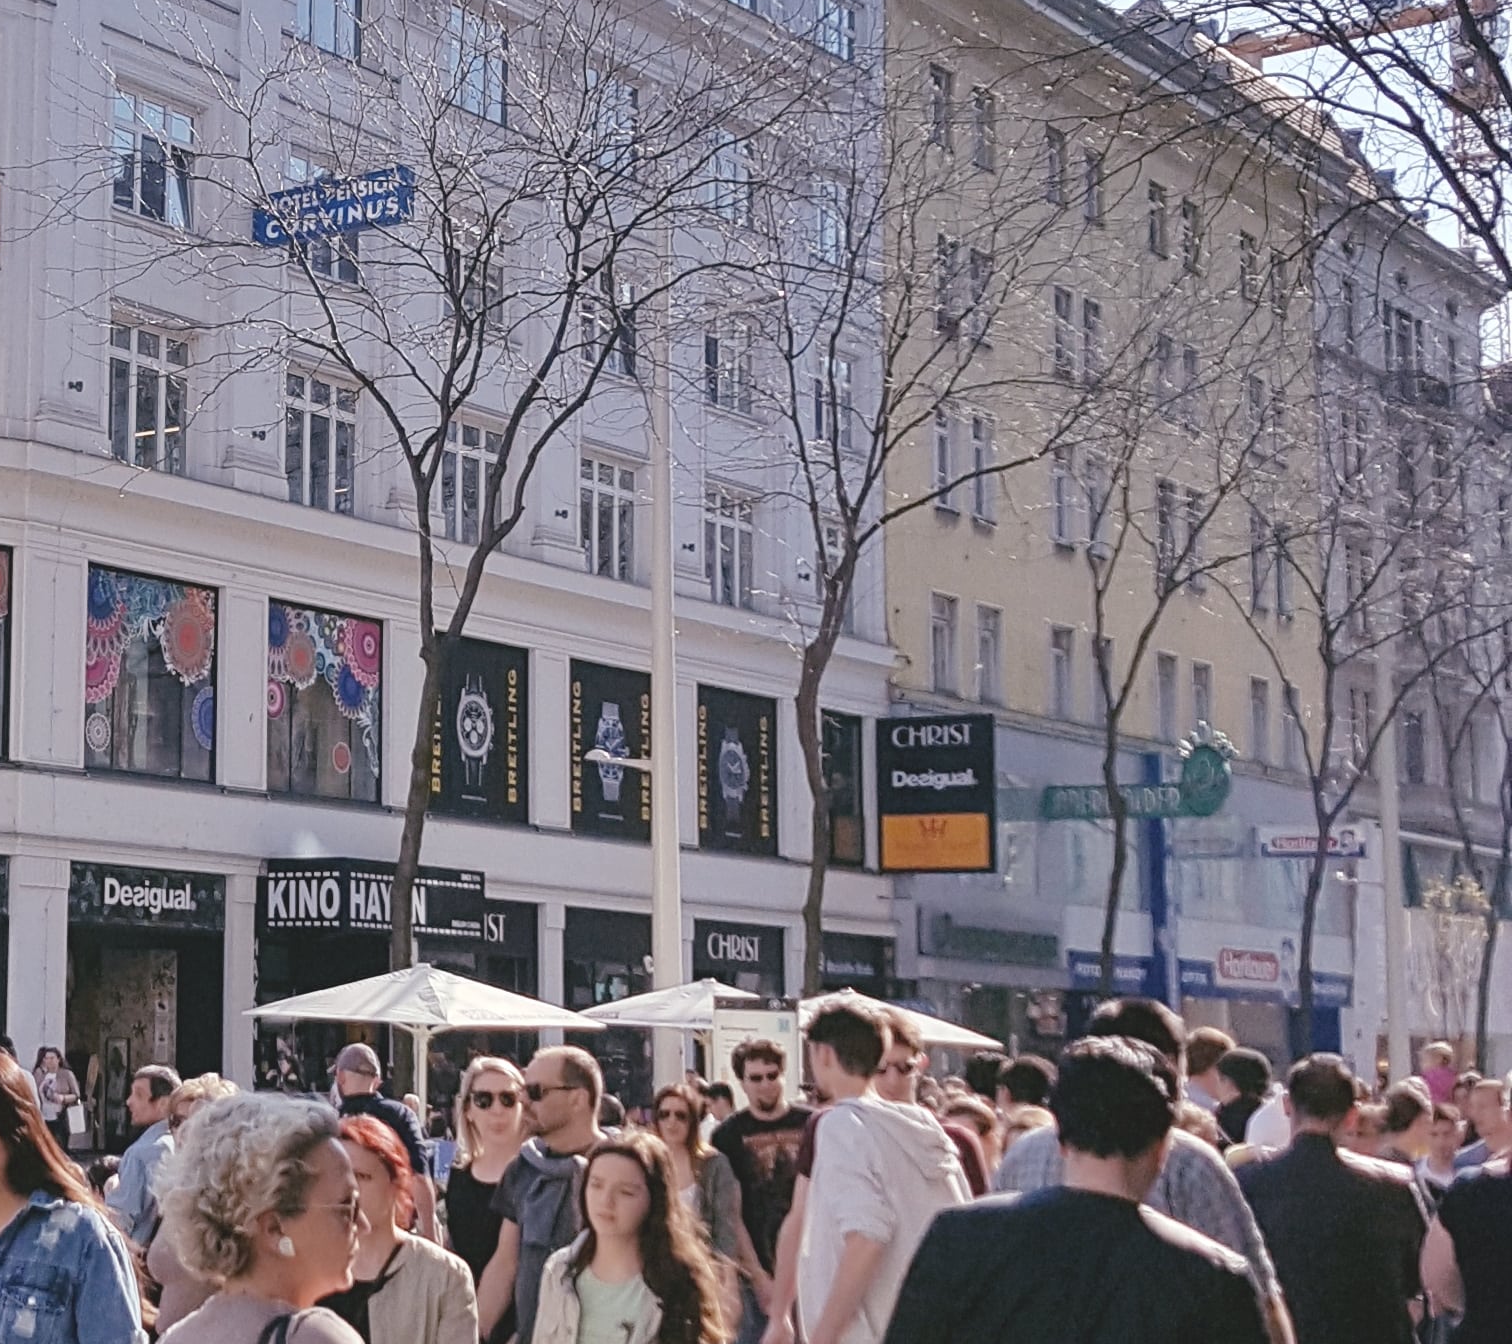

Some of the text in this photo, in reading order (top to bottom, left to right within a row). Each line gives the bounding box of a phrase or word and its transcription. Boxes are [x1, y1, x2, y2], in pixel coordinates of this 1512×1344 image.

[508, 669, 518, 803] BREITLING
[573, 681, 582, 813] BREITLING
[892, 723, 973, 748] CHRIST
[699, 705, 708, 830] BREITLING
[104, 877, 192, 914] Desigual
[267, 878, 427, 926] KINO HAYN
[707, 932, 760, 962] CHRIST
